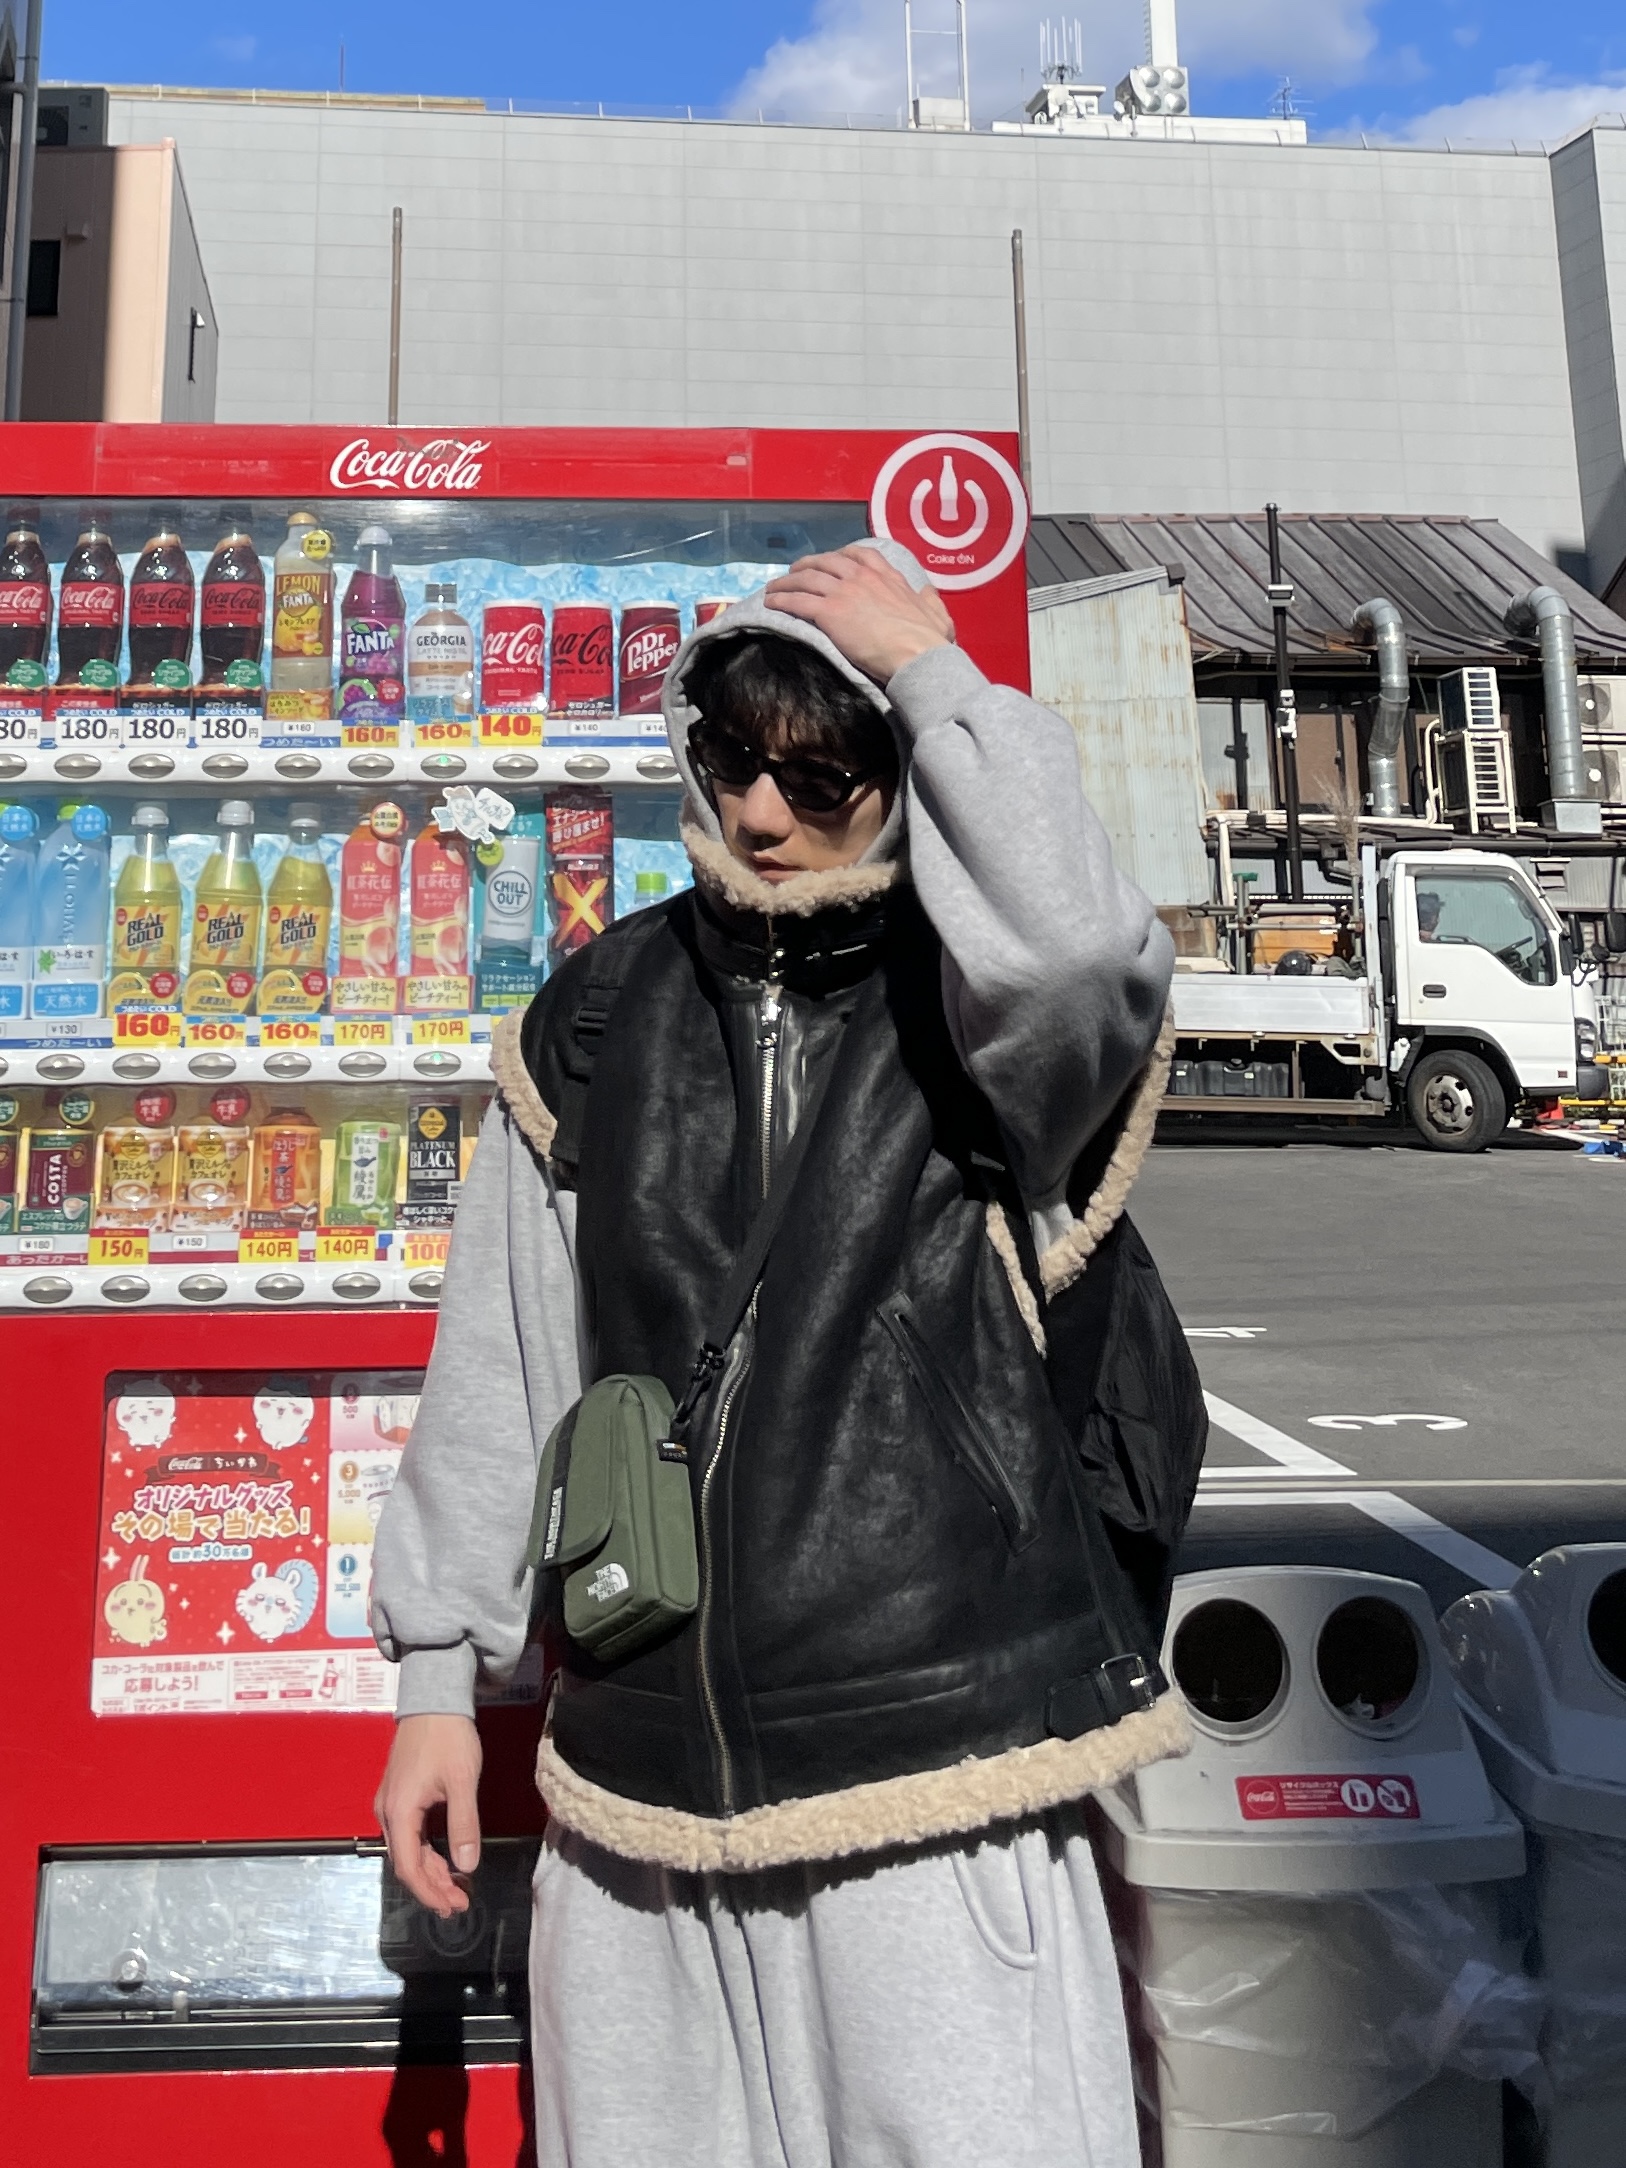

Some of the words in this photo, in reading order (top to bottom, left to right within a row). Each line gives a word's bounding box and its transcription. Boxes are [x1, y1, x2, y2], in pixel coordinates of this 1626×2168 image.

[329, 438, 492, 490] Coca-Cola
[926, 553, 955, 564] Coke
[957, 553, 975, 564] ON
[276, 575, 321, 597] LEMON
[282, 593, 315, 609] FANTA
[346, 630, 395, 655] FANTA
[416, 632, 467, 646] GEORGIA
[641, 631, 667, 651] Dr
[626, 640, 679, 674] Pepper
[61, 719, 119, 740] 180円
[129, 718, 187, 739] 180円
[201, 718, 259, 739] 180円
[344, 726, 397, 743] 160円
[417, 723, 471, 741] 160円
[481, 715, 542, 737] 140円
[493, 881, 528, 895] CHILL
[496, 894, 524, 906] OUT
[128, 911, 163, 934] REAL
[208, 911, 244, 932] REAL
[281, 911, 317, 932] REAL
[127, 926, 164, 947] GOLD
[207, 925, 244, 945] GOLD
[280, 925, 316, 945] GOLD
[44, 994, 87, 1008] 天然水
[148, 1005, 178, 1013] COLD
[51, 1025, 78, 1035] ¥130
[116, 1013, 180, 1037] 160円
[189, 1023, 244, 1041] 160円
[263, 1022, 318, 1040] 160円
[340, 1023, 386, 1040] 170円
[419, 1020, 464, 1038] 170円
[410, 1141, 456, 1150] PLATINUM
[409, 1150, 456, 1169] BLACK
[47, 1154, 62, 1205] COSTA
[100, 1239, 144, 1257] 150円
[246, 1241, 292, 1257] 140円
[323, 1239, 369, 1255] 140円
[1307, 1413, 1469, 1431] 3
[168, 1457, 204, 1471] Coca-Cola
[345, 1464, 353, 1476] 3
[133, 1480, 294, 1512] オリジナルグッズ
[111, 1506, 312, 1544] その場で当たる!
[123, 1675, 199, 1693] 応募しよう!
[1246, 1791, 1275, 1803] Coca-Cola
